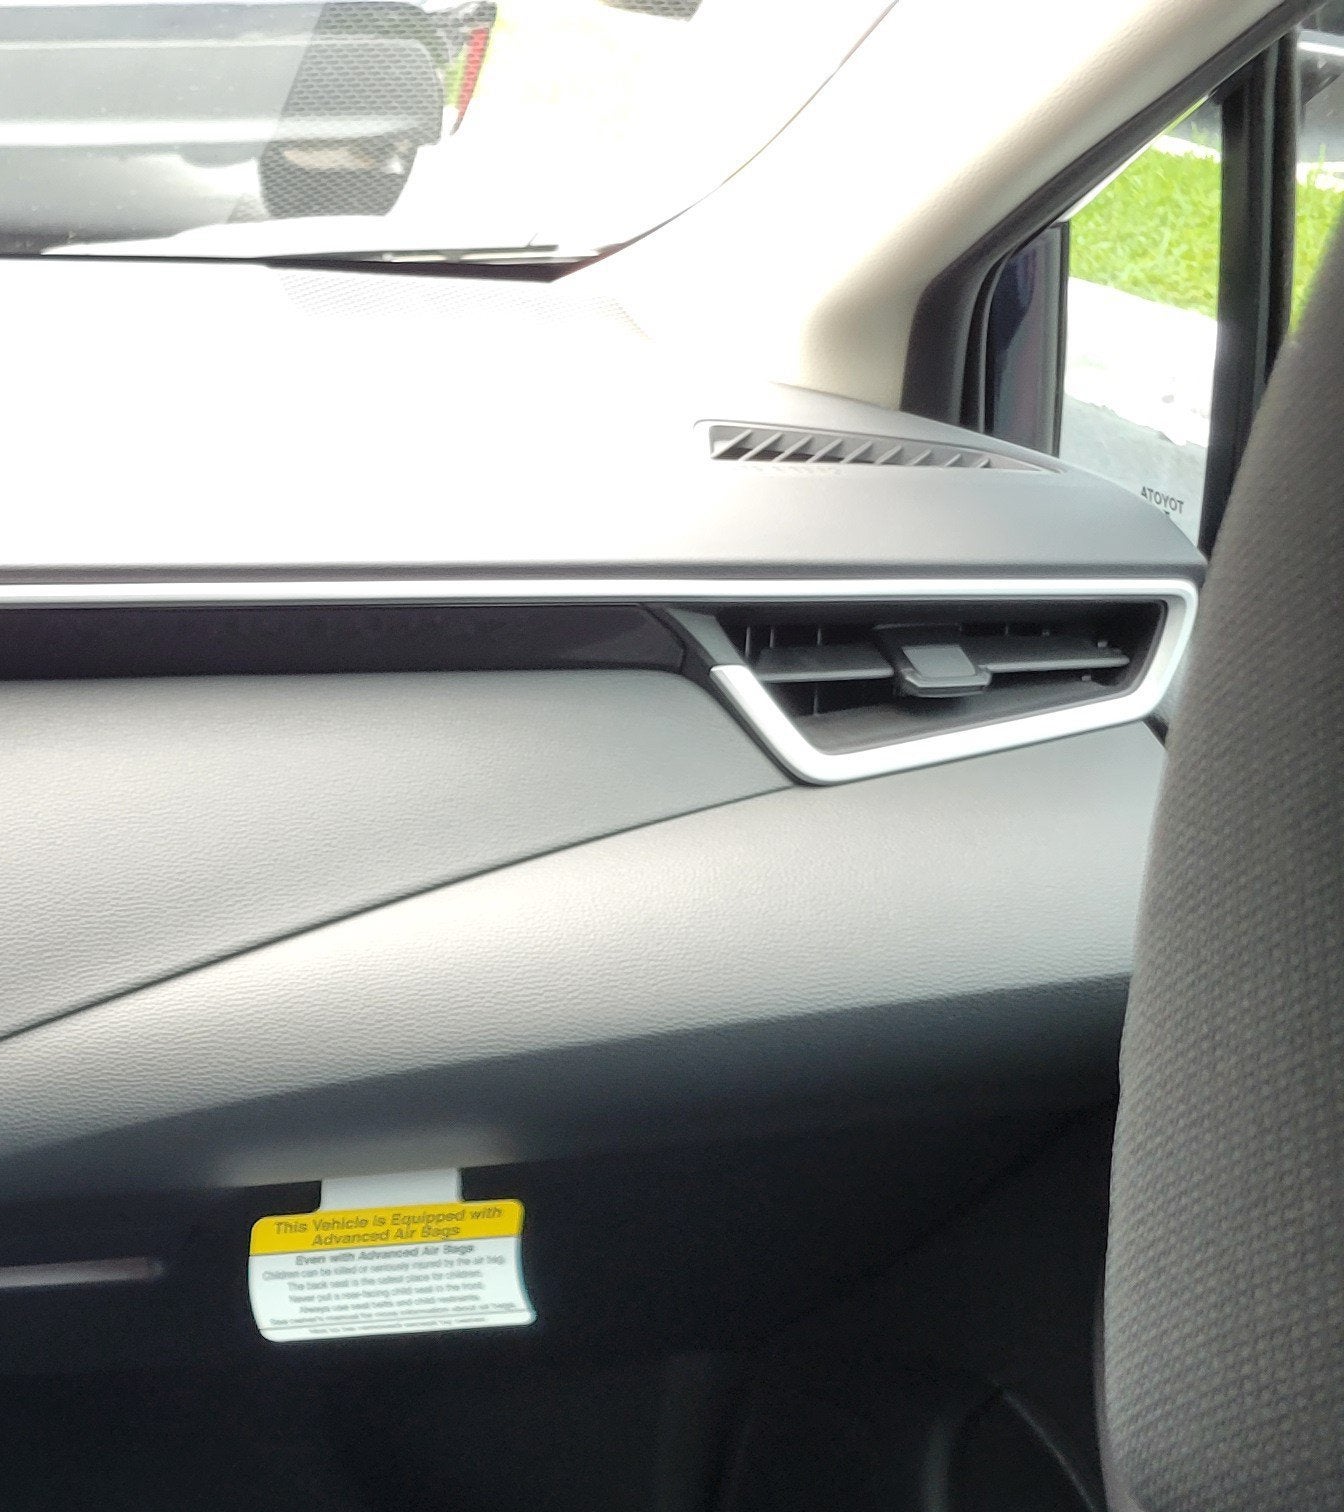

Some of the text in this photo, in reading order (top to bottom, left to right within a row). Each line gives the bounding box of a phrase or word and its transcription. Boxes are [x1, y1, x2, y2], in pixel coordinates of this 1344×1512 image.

[274, 1220, 308, 1235] This
[312, 1217, 368, 1233] Vehicle
[391, 1209, 466, 1229] Equipped
[470, 1205, 503, 1220] with
[312, 1226, 460, 1246] Advanced Air Bags
